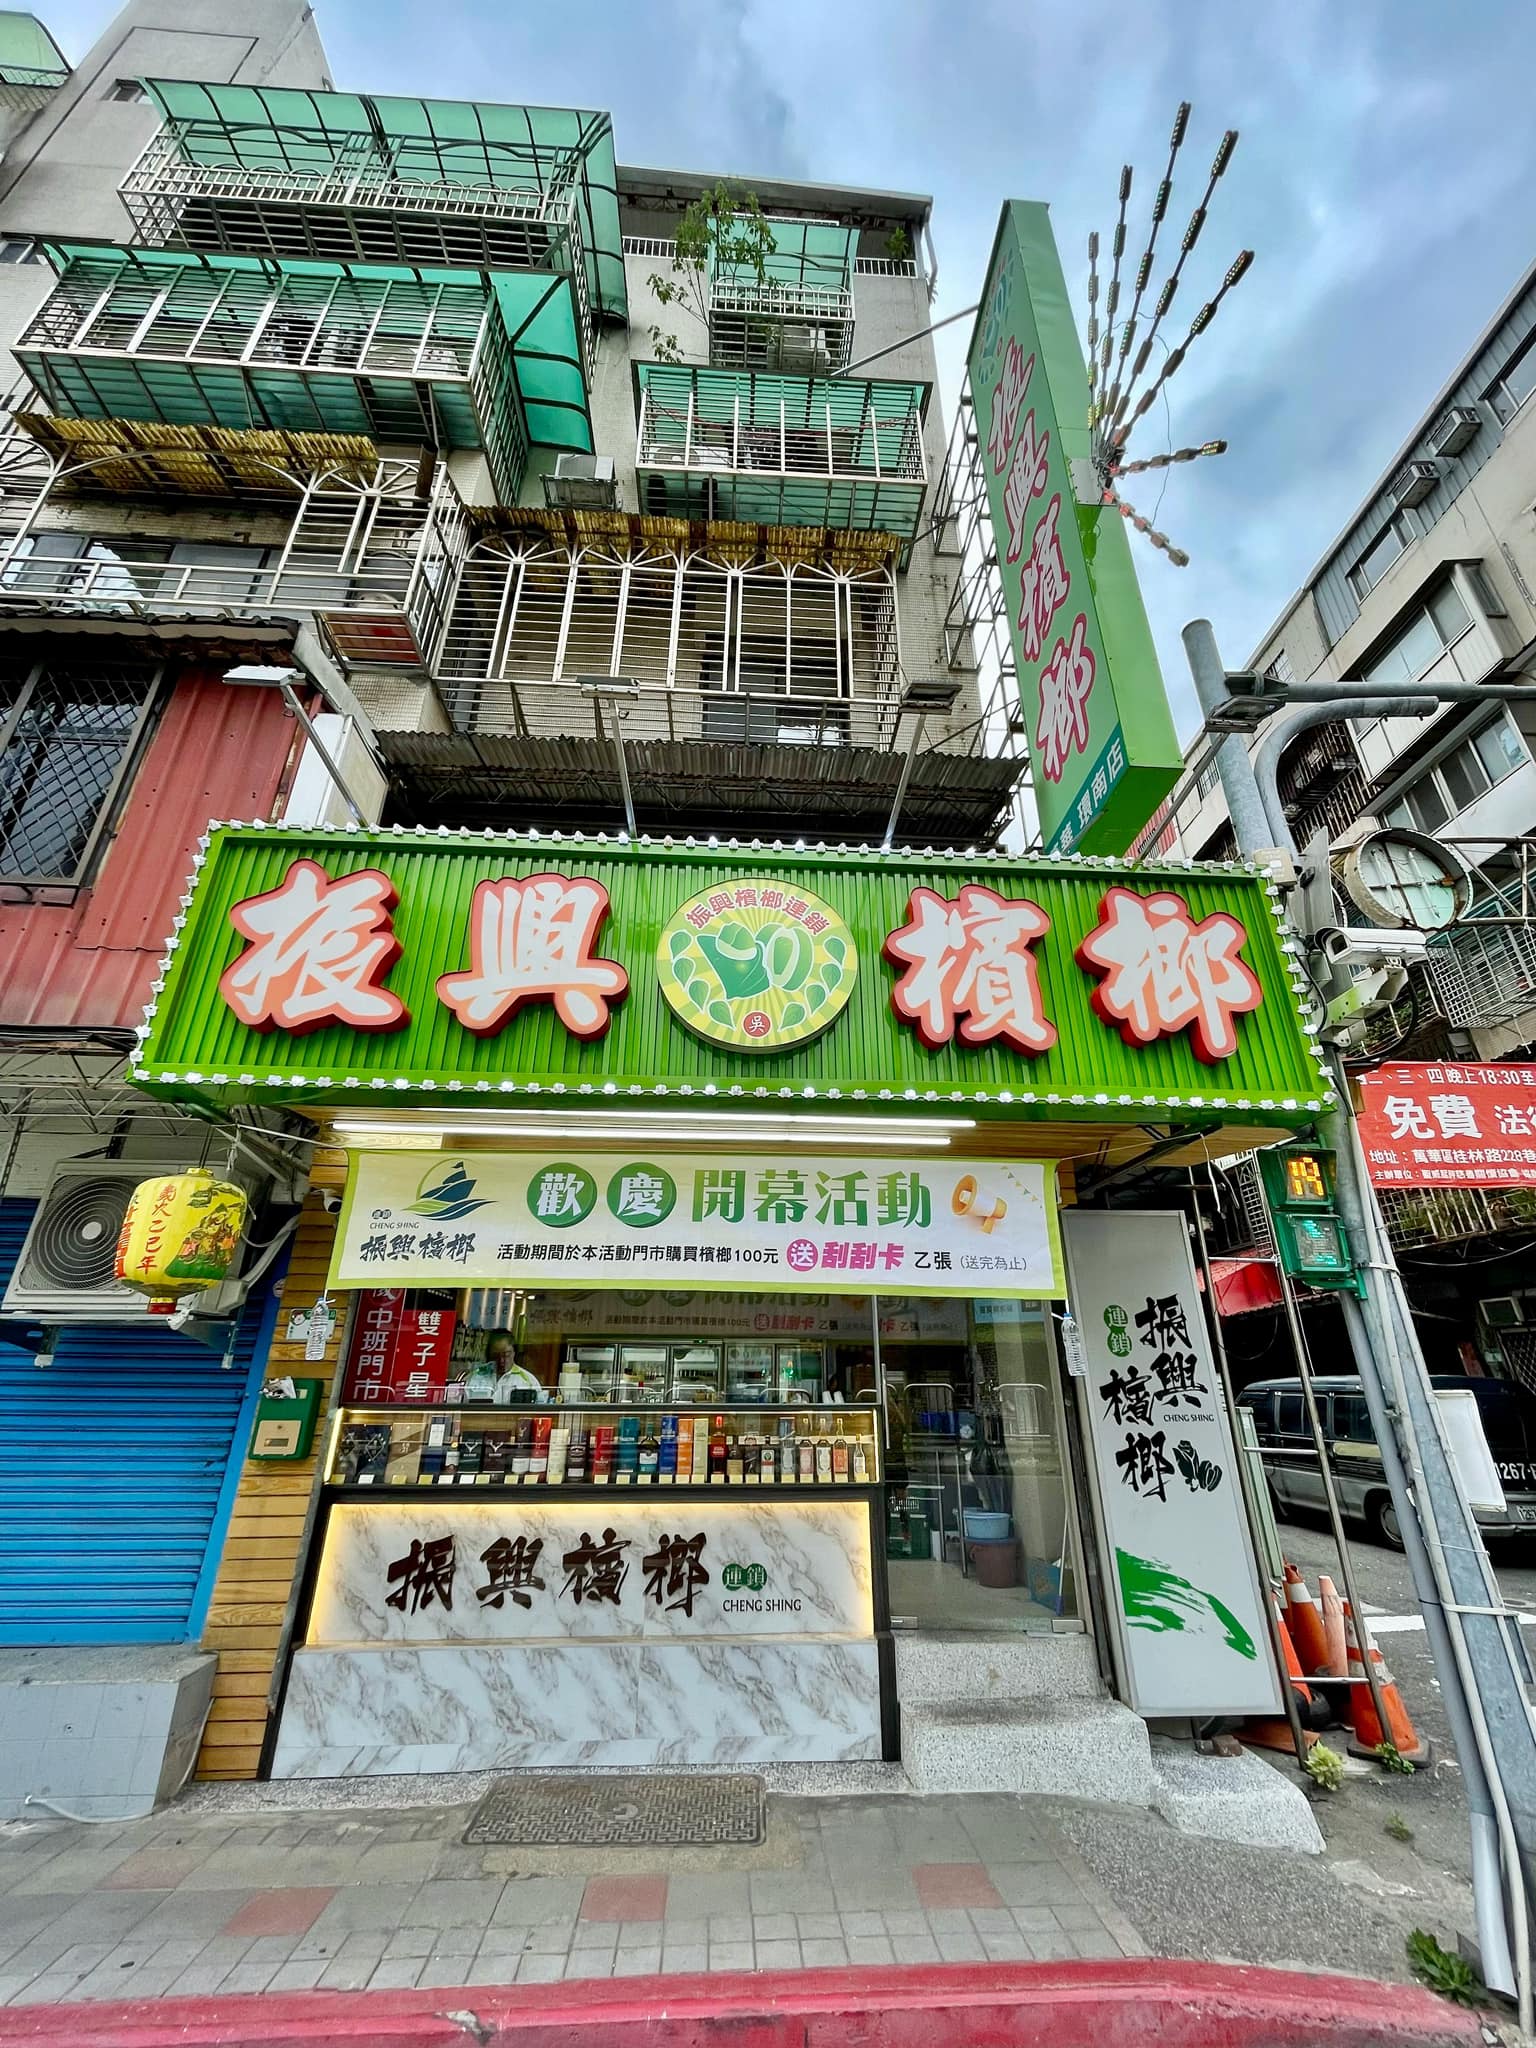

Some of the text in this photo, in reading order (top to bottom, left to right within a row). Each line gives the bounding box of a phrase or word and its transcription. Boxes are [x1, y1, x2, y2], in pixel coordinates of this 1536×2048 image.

[685, 887, 832, 936] 振興檳榔連鎖
[748, 1014, 766, 1034] 吳
[1383, 1093, 1484, 1140] 免費
[360, 1232, 475, 1265] 振興檳榔
[497, 1243, 779, 1265] 活動期間於本活動門市購買檳榔100元
[914, 1250, 952, 1271] 乙張
[353, 1307, 392, 1400] 中班門市
[1107, 1307, 1131, 1354] 連鎖
[404, 1311, 442, 1398] 雙子星
[1163, 1413, 1215, 1423] CHENG SHING
[386, 1527, 767, 1617] 振興檳榔 連鎖
[723, 1599, 801, 1613] CHENG SHING
